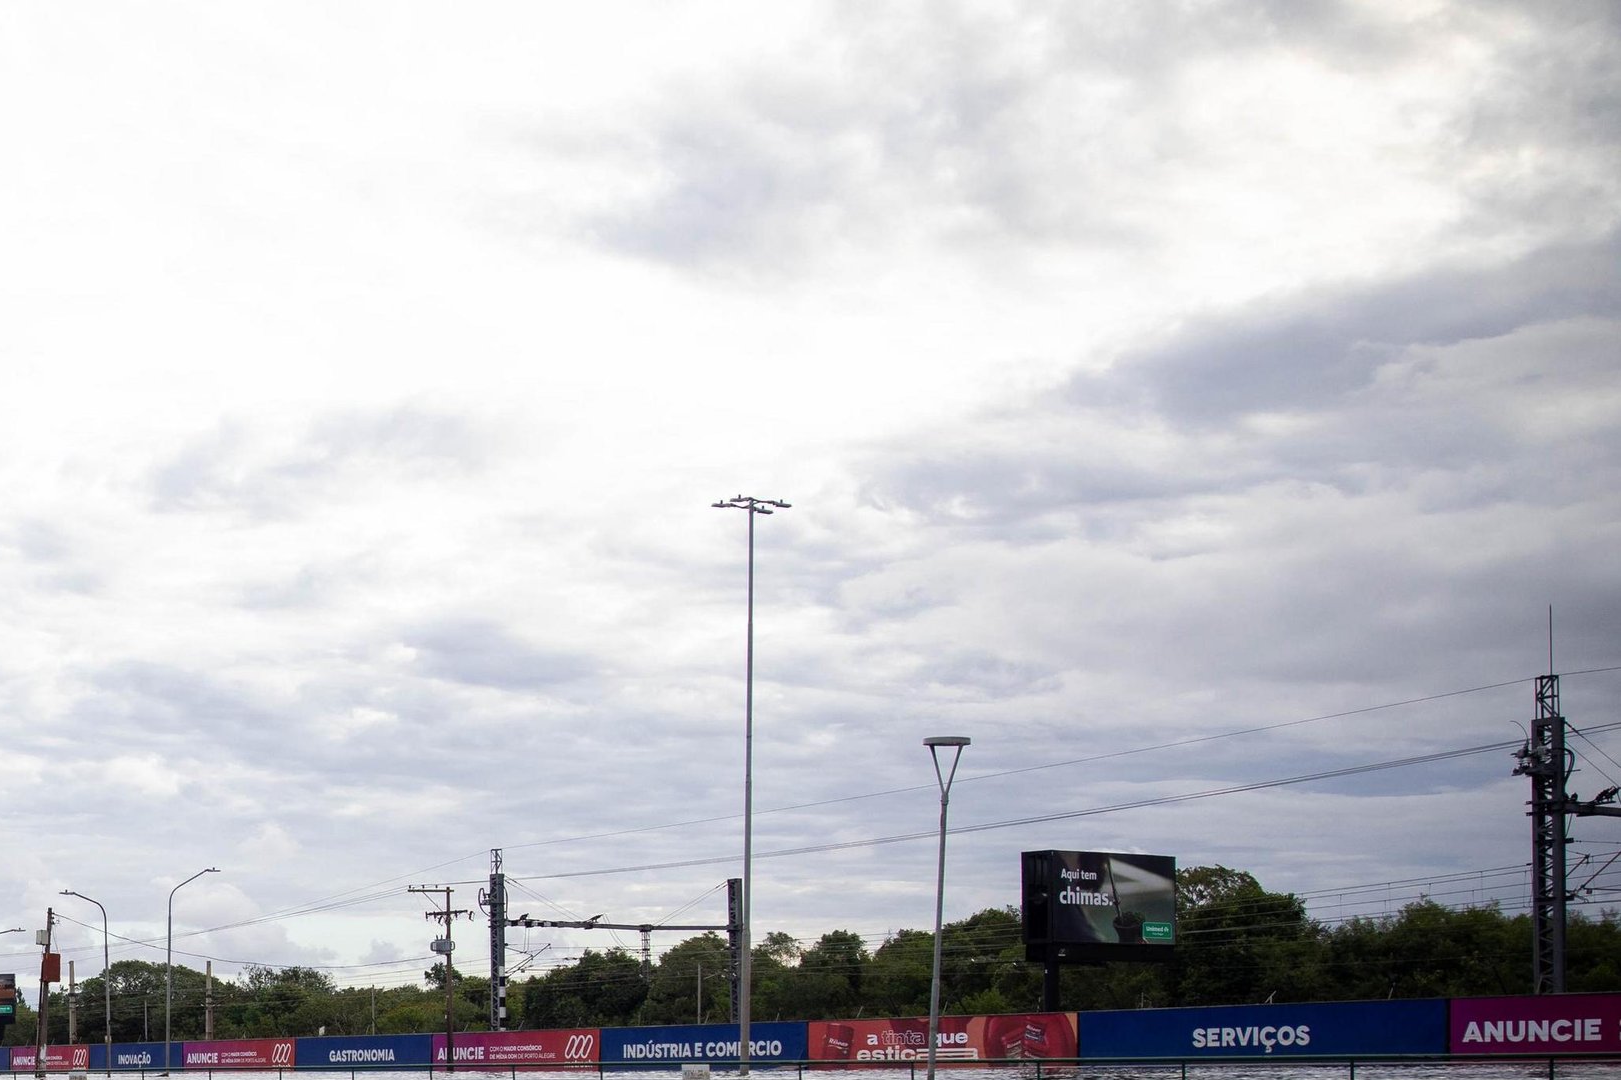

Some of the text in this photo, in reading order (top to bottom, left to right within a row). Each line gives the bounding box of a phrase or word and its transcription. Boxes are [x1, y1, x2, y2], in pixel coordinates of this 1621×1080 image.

[1060, 868, 1097, 883] Aqui tem
[1059, 886, 1113, 906] chimas.
[867, 1034, 878, 1046] a
[881, 1030, 926, 1045] tinta
[1462, 1018, 1602, 1043] ANUNCIE
[1192, 1025, 1311, 1053] SERVIÇOS
[329, 1049, 395, 1062] GASTRONOMIA
[623, 1040, 782, 1059] INDÚSTRIA E COMRCIO
[12, 1056, 36, 1066] ANUNCIE
[118, 1051, 151, 1068] INOVAÇÃO
[186, 1052, 218, 1064] ANUNCIE
